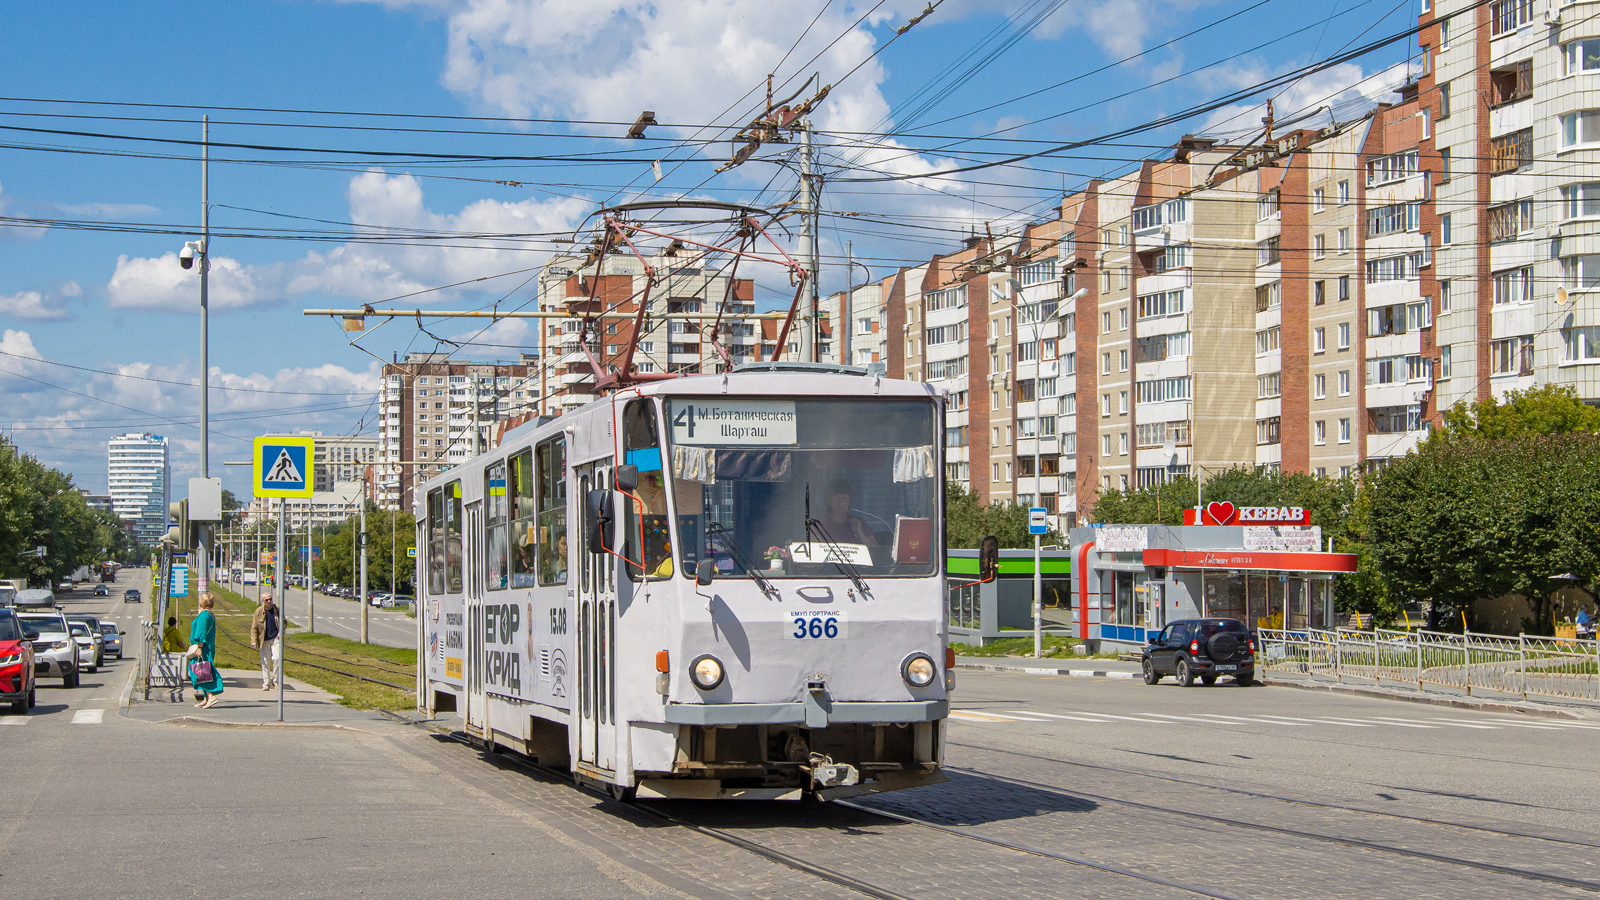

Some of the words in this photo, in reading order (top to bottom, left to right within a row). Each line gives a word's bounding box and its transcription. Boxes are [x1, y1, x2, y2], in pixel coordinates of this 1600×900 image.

[674, 405, 696, 438] 4
[698, 407, 793, 421] М.Ботаническая
[721, 424, 767, 439] Шарташ
[1194, 506, 1203, 525] I
[1239, 507, 1304, 521] KEBAB
[485, 603, 520, 645] ЕГОР
[550, 607, 567, 635] 15.08
[793, 617, 838, 639] 366
[485, 650, 521, 696] КРИД
